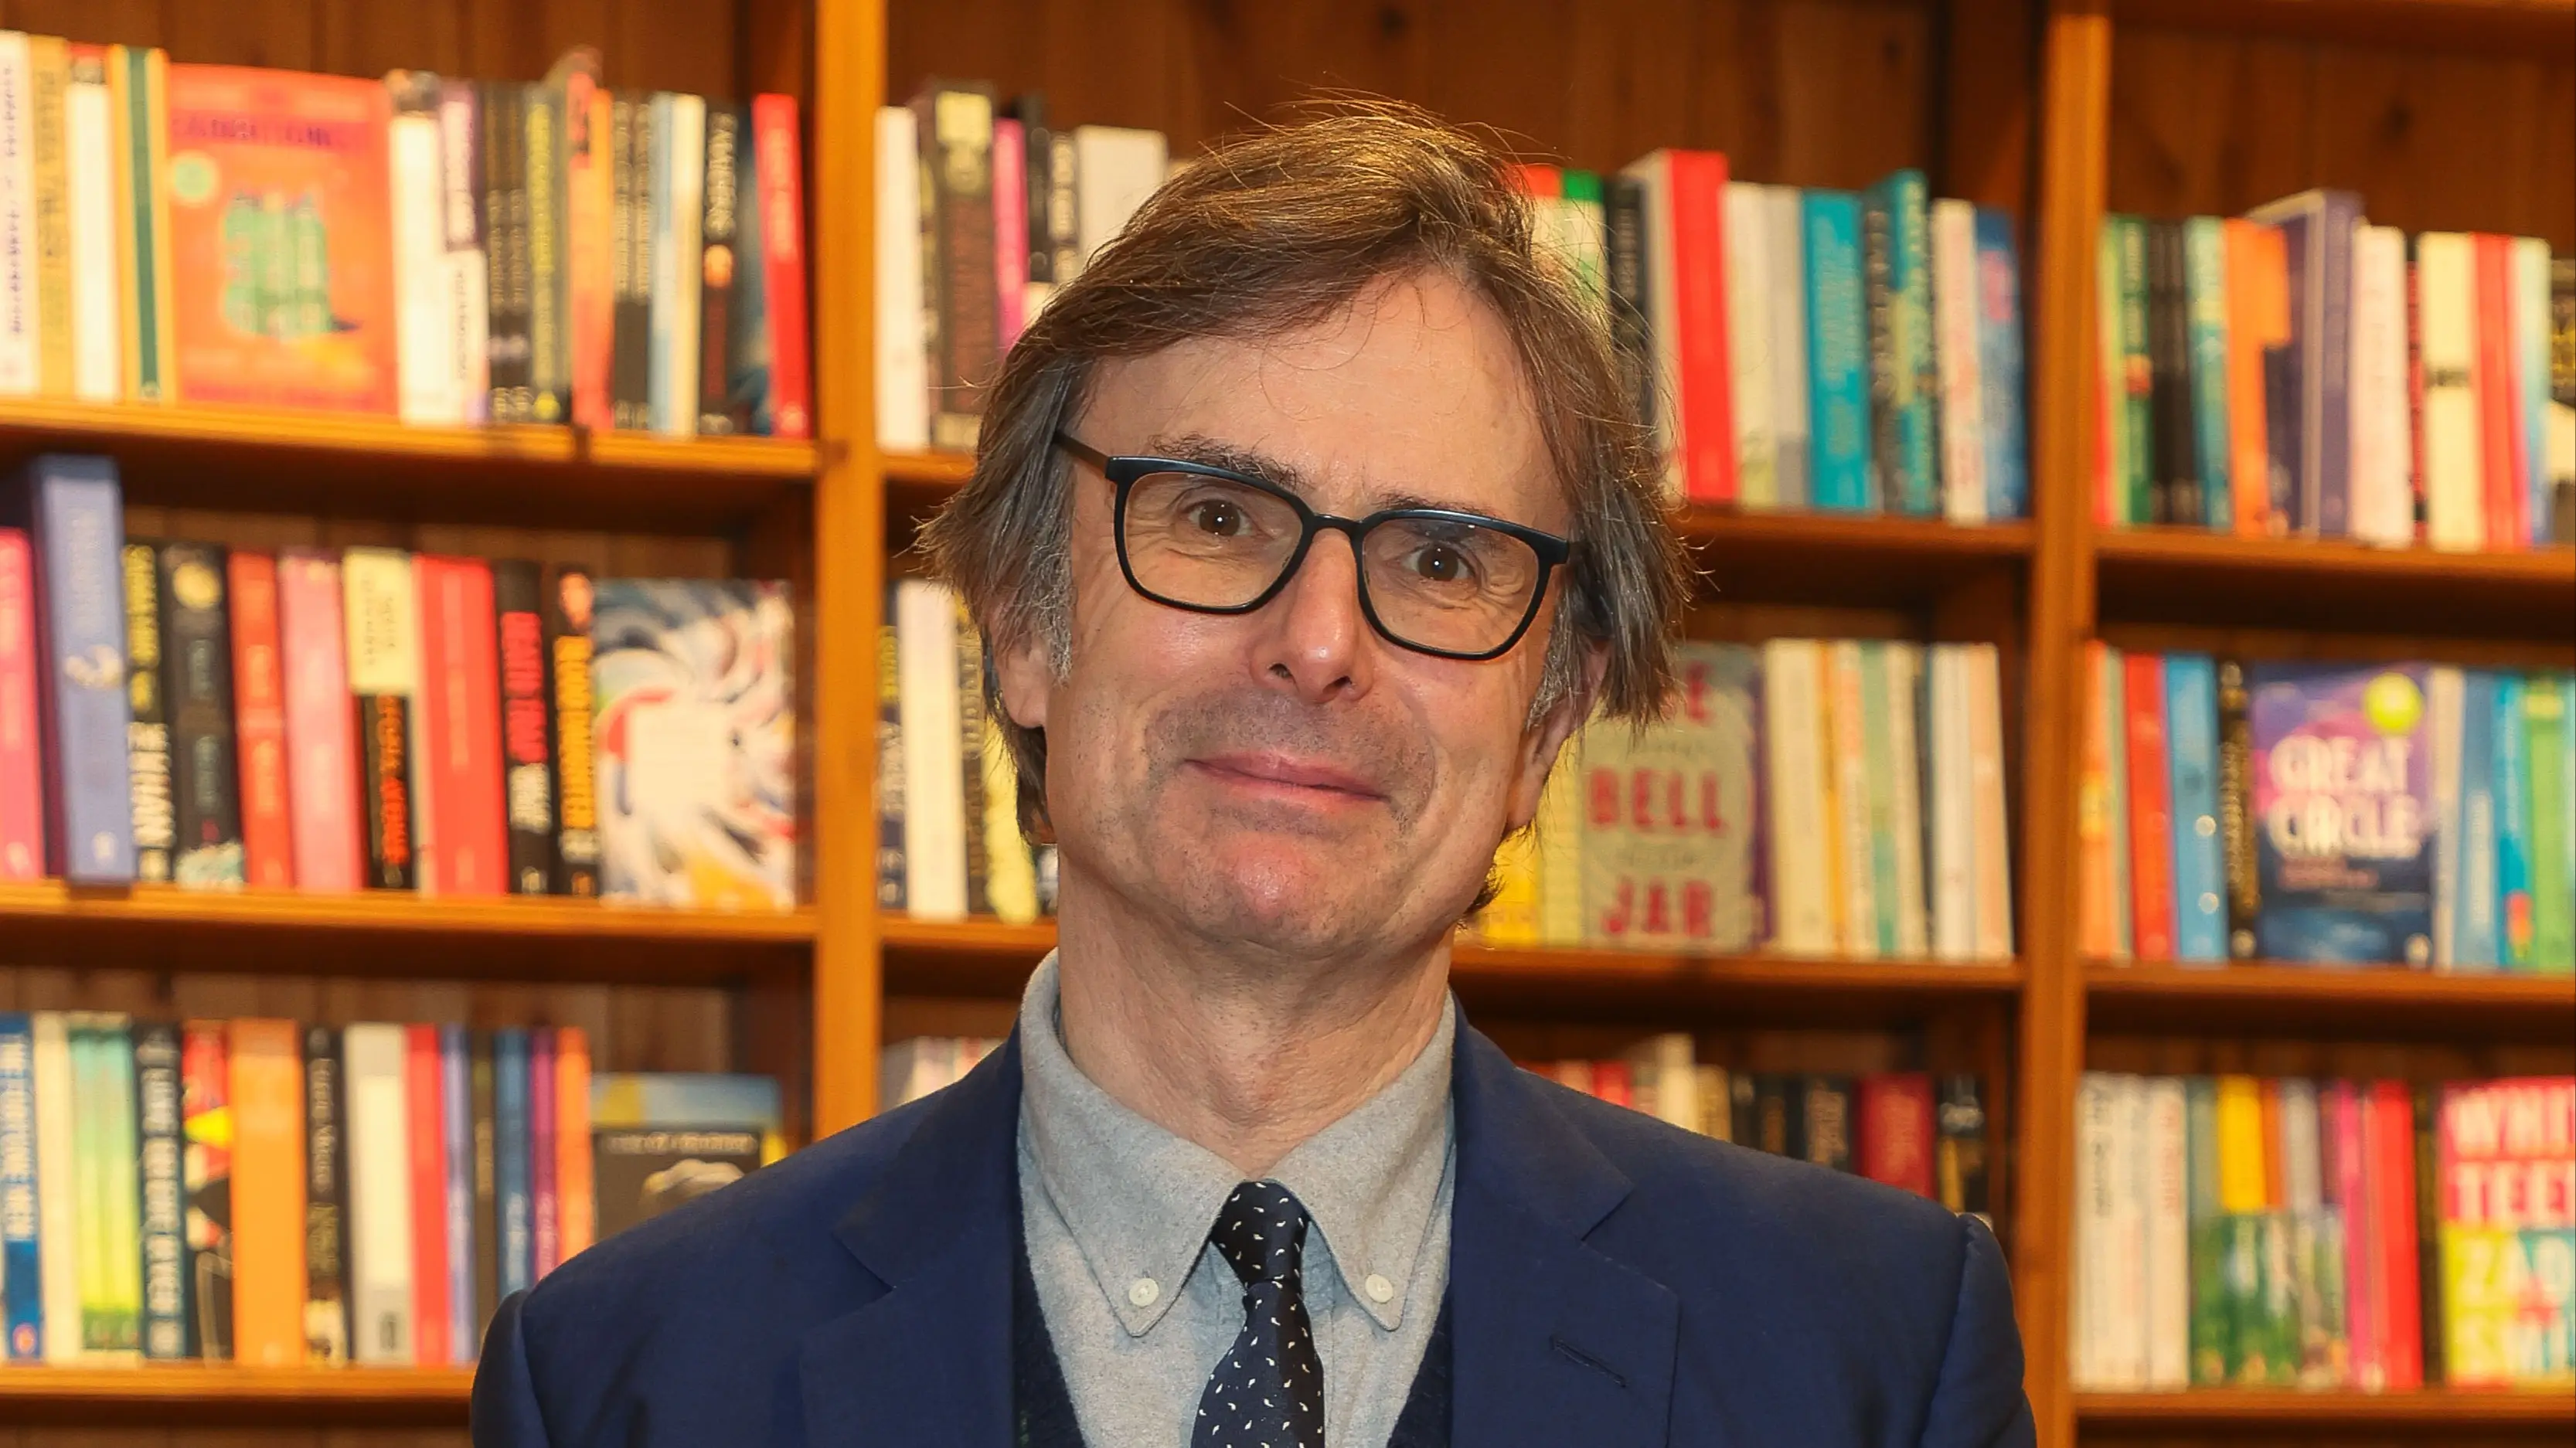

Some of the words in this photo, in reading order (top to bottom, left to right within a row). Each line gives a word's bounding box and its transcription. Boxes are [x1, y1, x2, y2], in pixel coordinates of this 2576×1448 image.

[501, 612, 543, 697] DEATH
[554, 636, 594, 709] BLOOD
[506, 699, 548, 763] TRAP
[2268, 736, 2408, 791] GREAT
[131, 753, 175, 847] KHAN
[558, 710, 597, 830] DAUGHTER
[1587, 765, 1728, 838] BELL
[378, 777, 410, 865] AVENUE
[2268, 794, 2421, 858] CIRCLE
[1602, 875, 1713, 938] JAR
[2087, 1136, 2112, 1217] Smith
